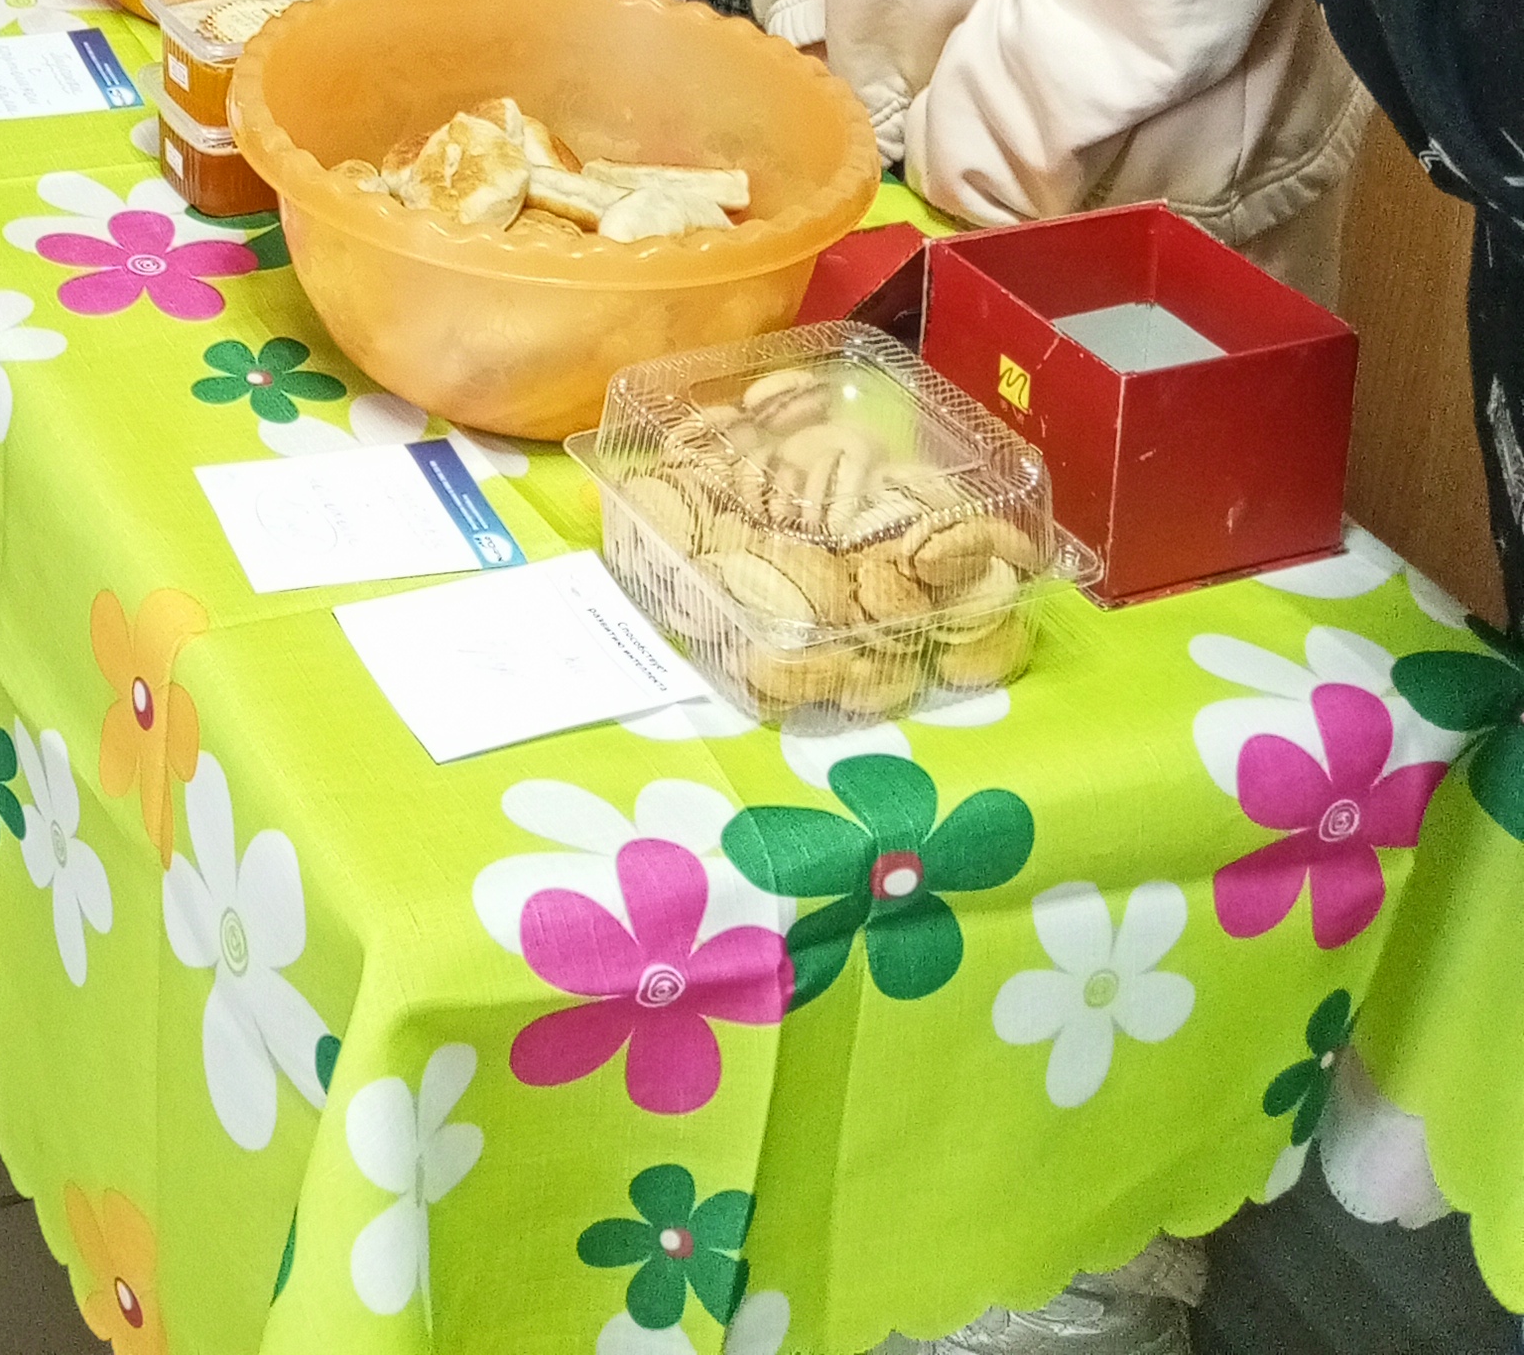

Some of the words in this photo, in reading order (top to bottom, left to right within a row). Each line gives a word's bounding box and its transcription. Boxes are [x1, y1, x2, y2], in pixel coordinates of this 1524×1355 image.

[587, 608, 625, 649] развитию
[623, 649, 668, 692] интеллекта
[617, 622, 668, 673] Способствует
